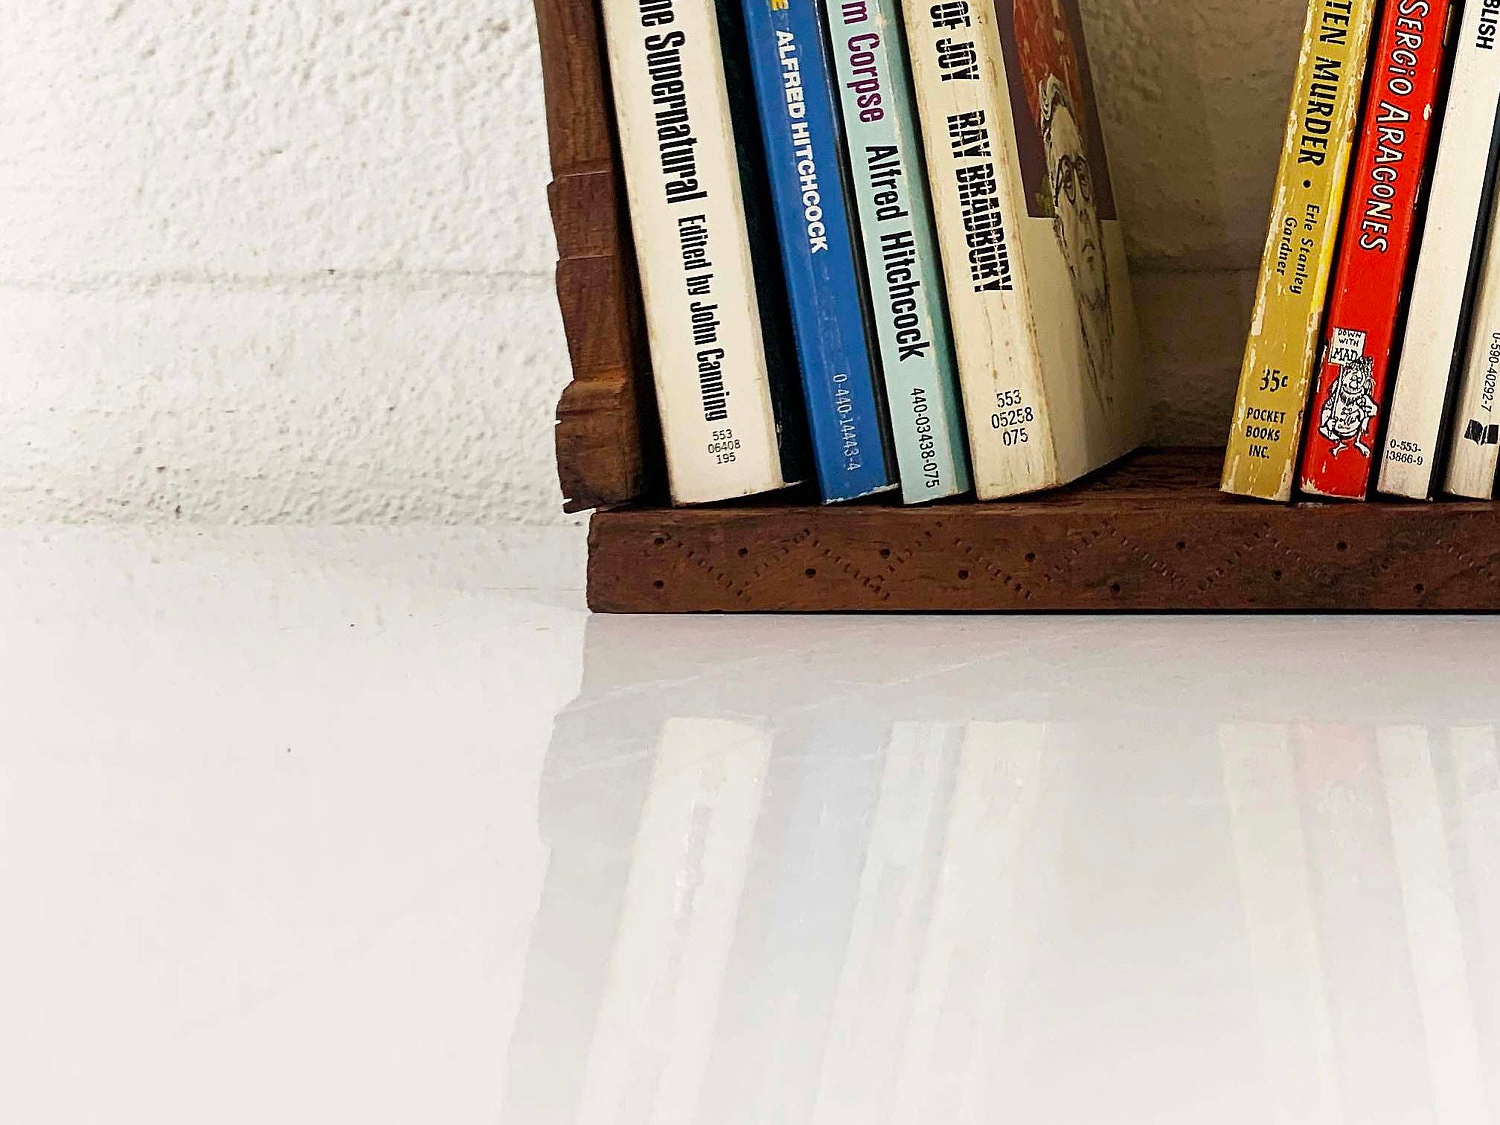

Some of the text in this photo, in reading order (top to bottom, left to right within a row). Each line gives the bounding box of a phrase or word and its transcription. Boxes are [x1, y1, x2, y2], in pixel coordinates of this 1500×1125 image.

[929, 0, 973, 31] OF
[935, 37, 981, 82] JOY
[847, 32, 885, 123] Corpse
[644, 32, 708, 205] Supernatural
[1297, 56, 1342, 167] MURDER
[776, 30, 829, 254] ALFRED HITCHCOCK
[1359, 101, 1411, 254] ARAGONES
[946, 109, 1013, 293] RAY BRADBURY
[865, 145, 931, 363] Alfred Hitchcock
[1276, 217, 1298, 276] Gardner
[1289, 203, 1320, 295] Erle Stanley
[678, 214, 728, 421] Edited by John Canning
[1338, 329, 1362, 339] DOWN
[1338, 338, 1360, 347] WITH
[1332, 347, 1358, 362] MAD
[996, 389, 1022, 409] 553
[991, 407, 1034, 430] 05258
[1246, 407, 1286, 424] POCKET
[712, 429, 733, 441] 553
[1002, 428, 1029, 447] 075
[1246, 425, 1280, 441] BOOKS
[707, 439, 741, 455] 06408
[1248, 444, 1270, 459] INC.
[1390, 439, 1422, 453] 0-553-
[716, 452, 736, 465] 195
[1385, 451, 1424, 465] 13866-9
